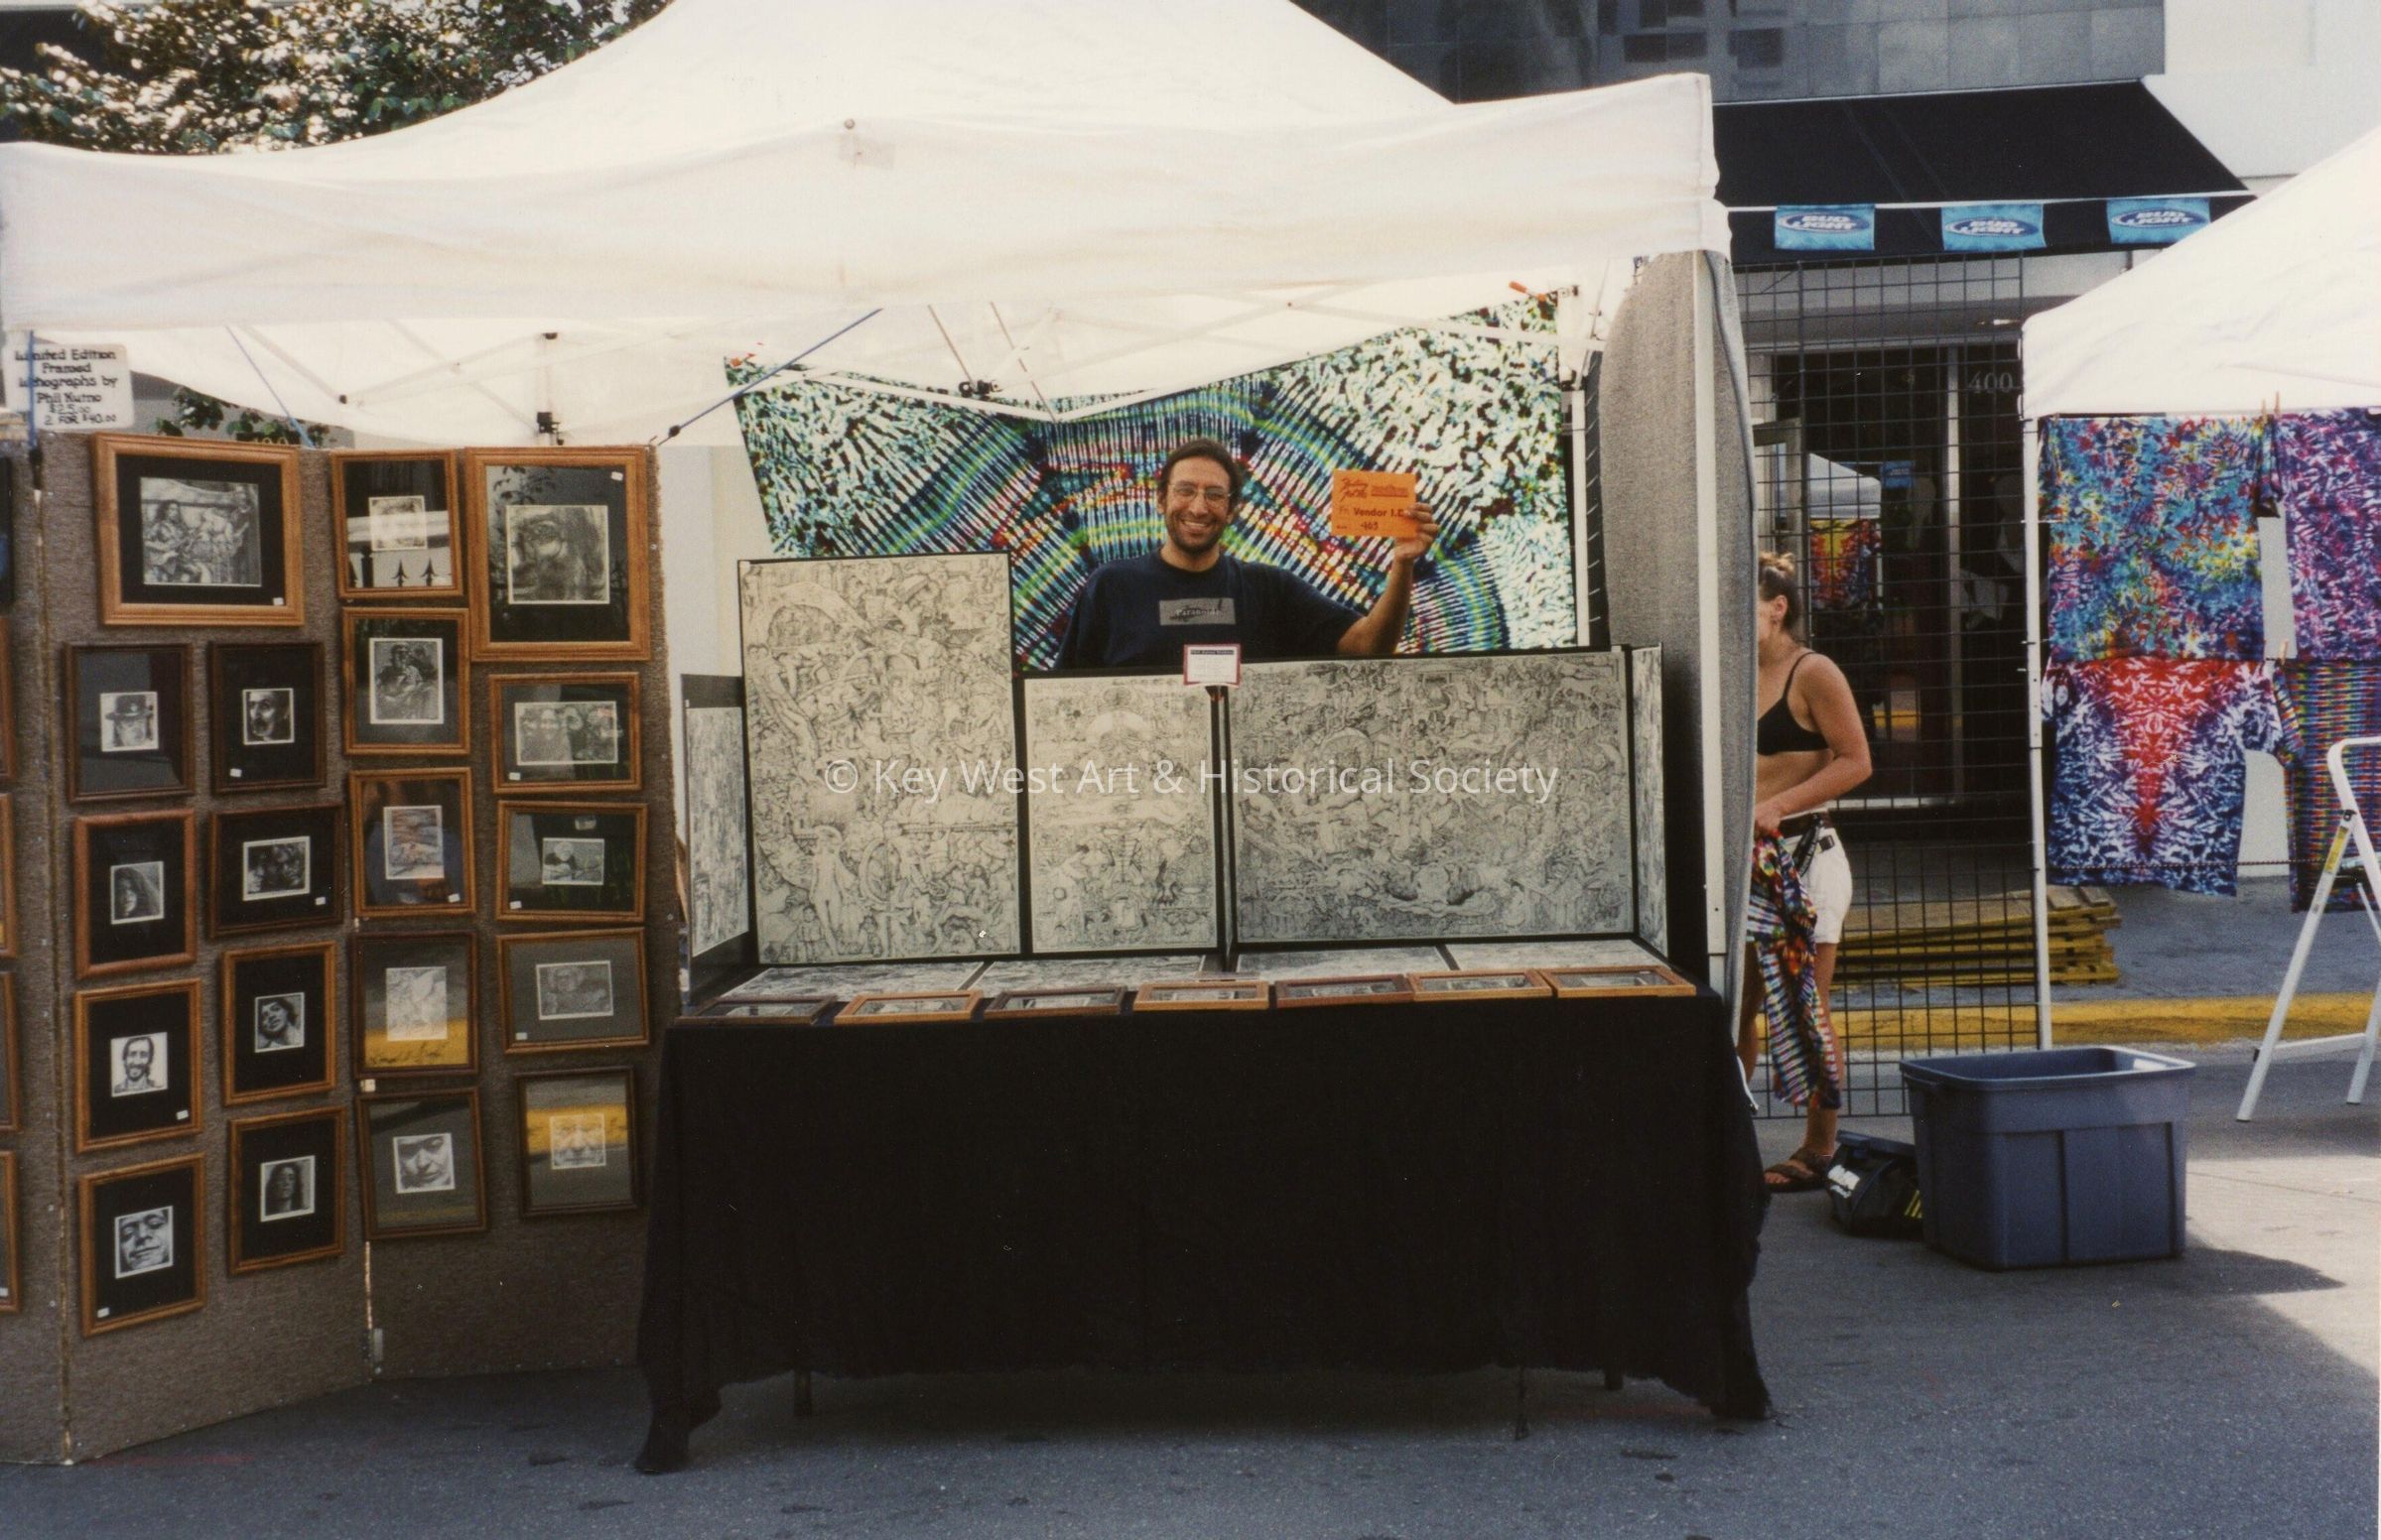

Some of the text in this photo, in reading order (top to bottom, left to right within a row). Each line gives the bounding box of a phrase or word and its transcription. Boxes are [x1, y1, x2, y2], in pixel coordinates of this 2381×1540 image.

[1792, 221, 1856, 230] LIGHT
[2126, 216, 2193, 225] LIGHT
[71, 348, 116, 360] Edition
[42, 362, 91, 373] Framed
[19, 375, 117, 389] Lihographs by
[1968, 370, 2014, 394] 400
[45, 415, 53, 425] 2
[1353, 507, 1388, 517] Vendor
